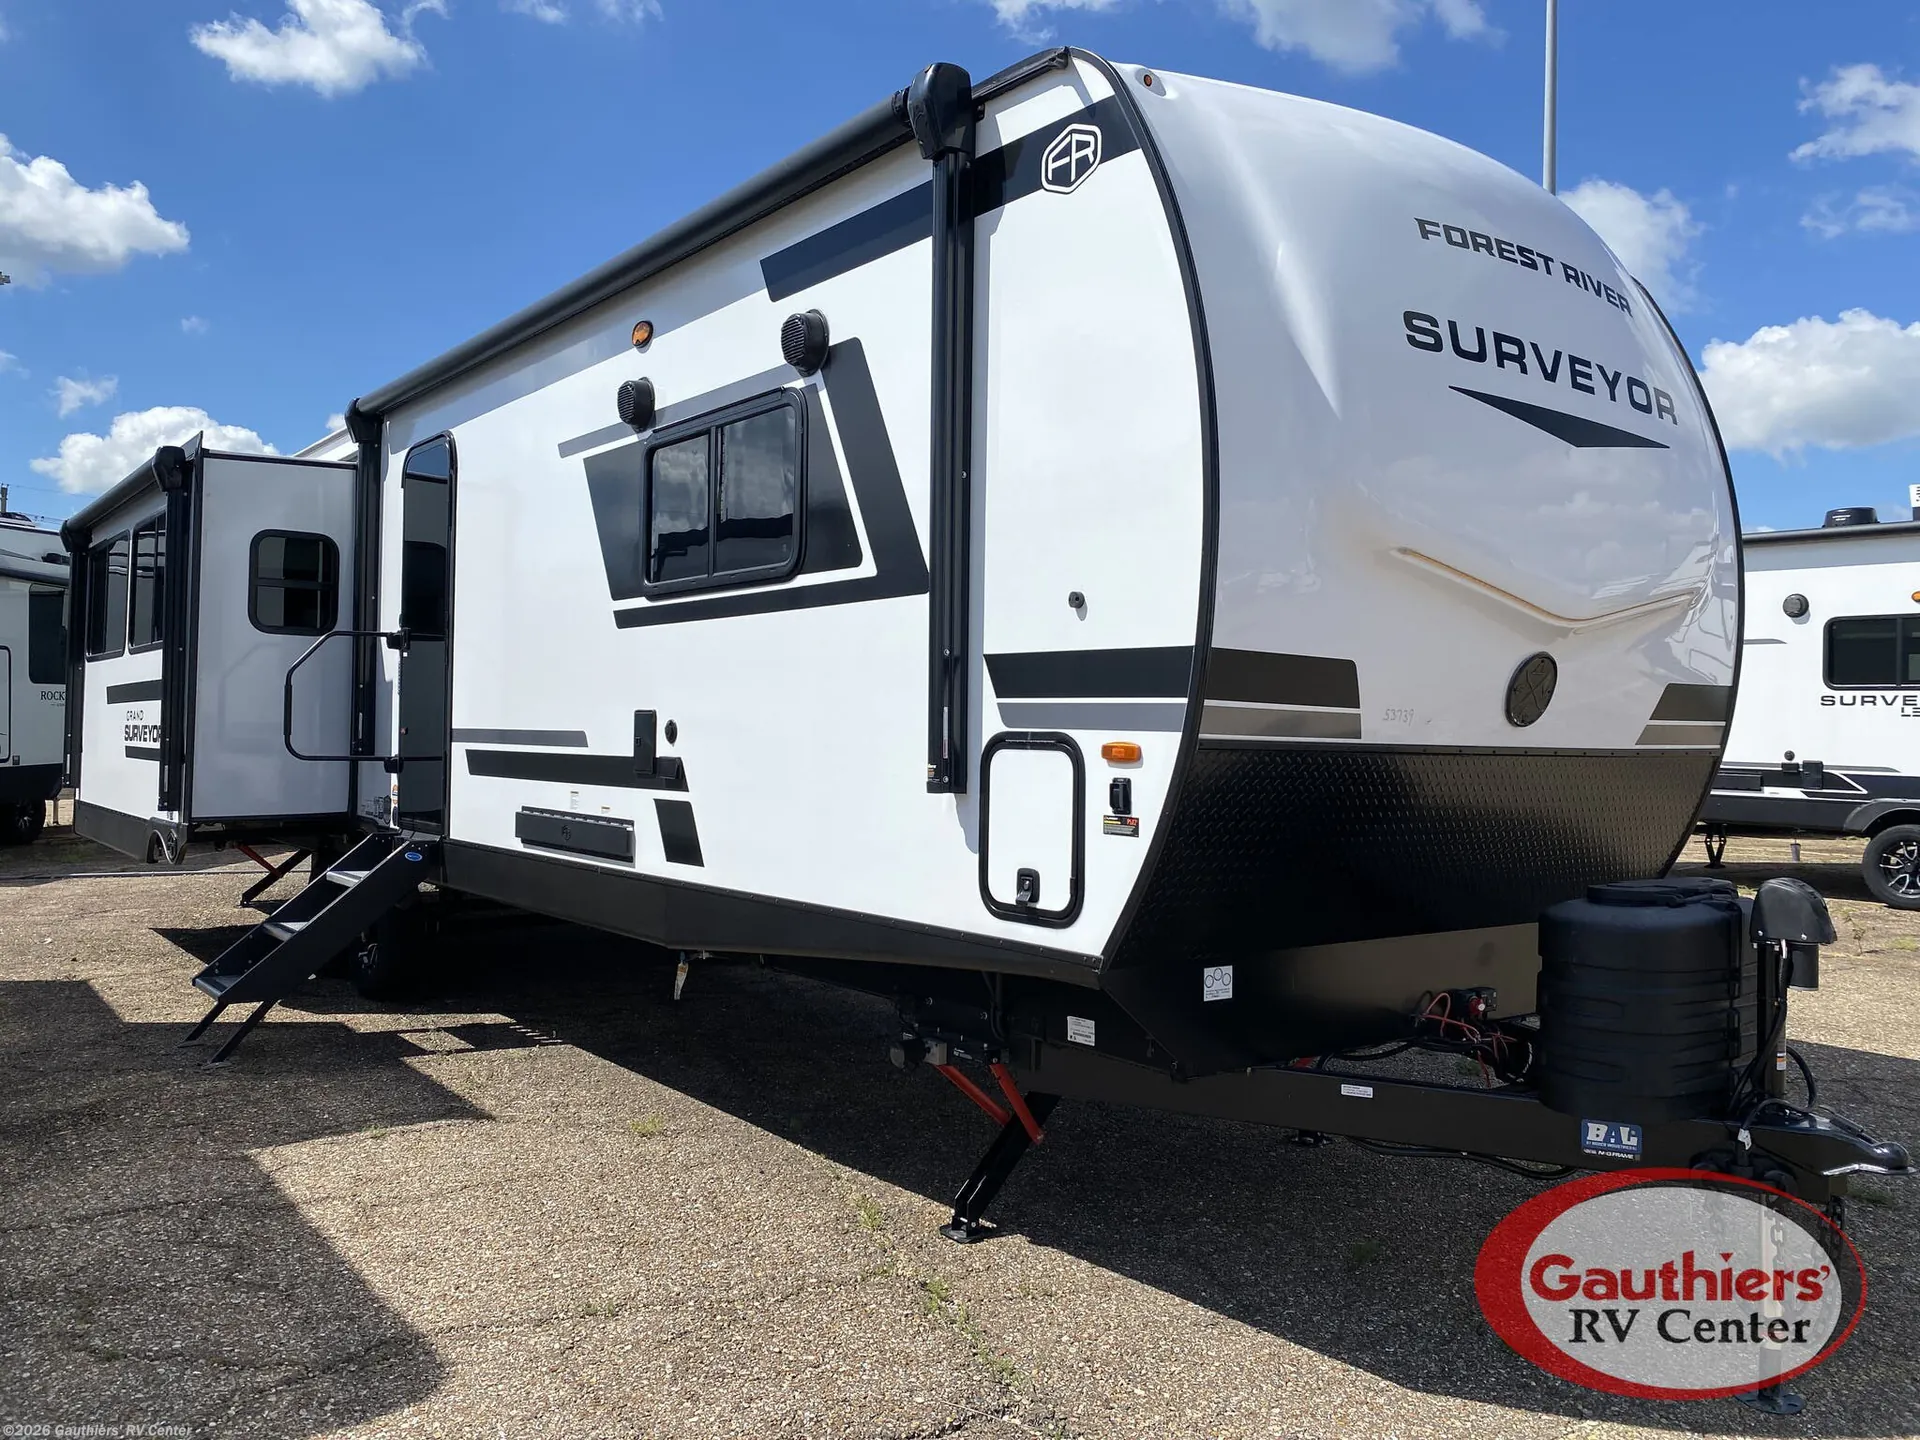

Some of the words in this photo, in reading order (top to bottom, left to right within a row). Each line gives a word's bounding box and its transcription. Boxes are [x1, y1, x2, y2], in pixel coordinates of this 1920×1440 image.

[1414, 217, 1554, 276] FOREST
[1560, 261, 1632, 317] RIVER
[1403, 310, 1678, 425] SURVEYOR
[1820, 695, 1918, 706] SURVE
[126, 710, 144, 721] GRAND
[1587, 1123, 1638, 1146] BAL
